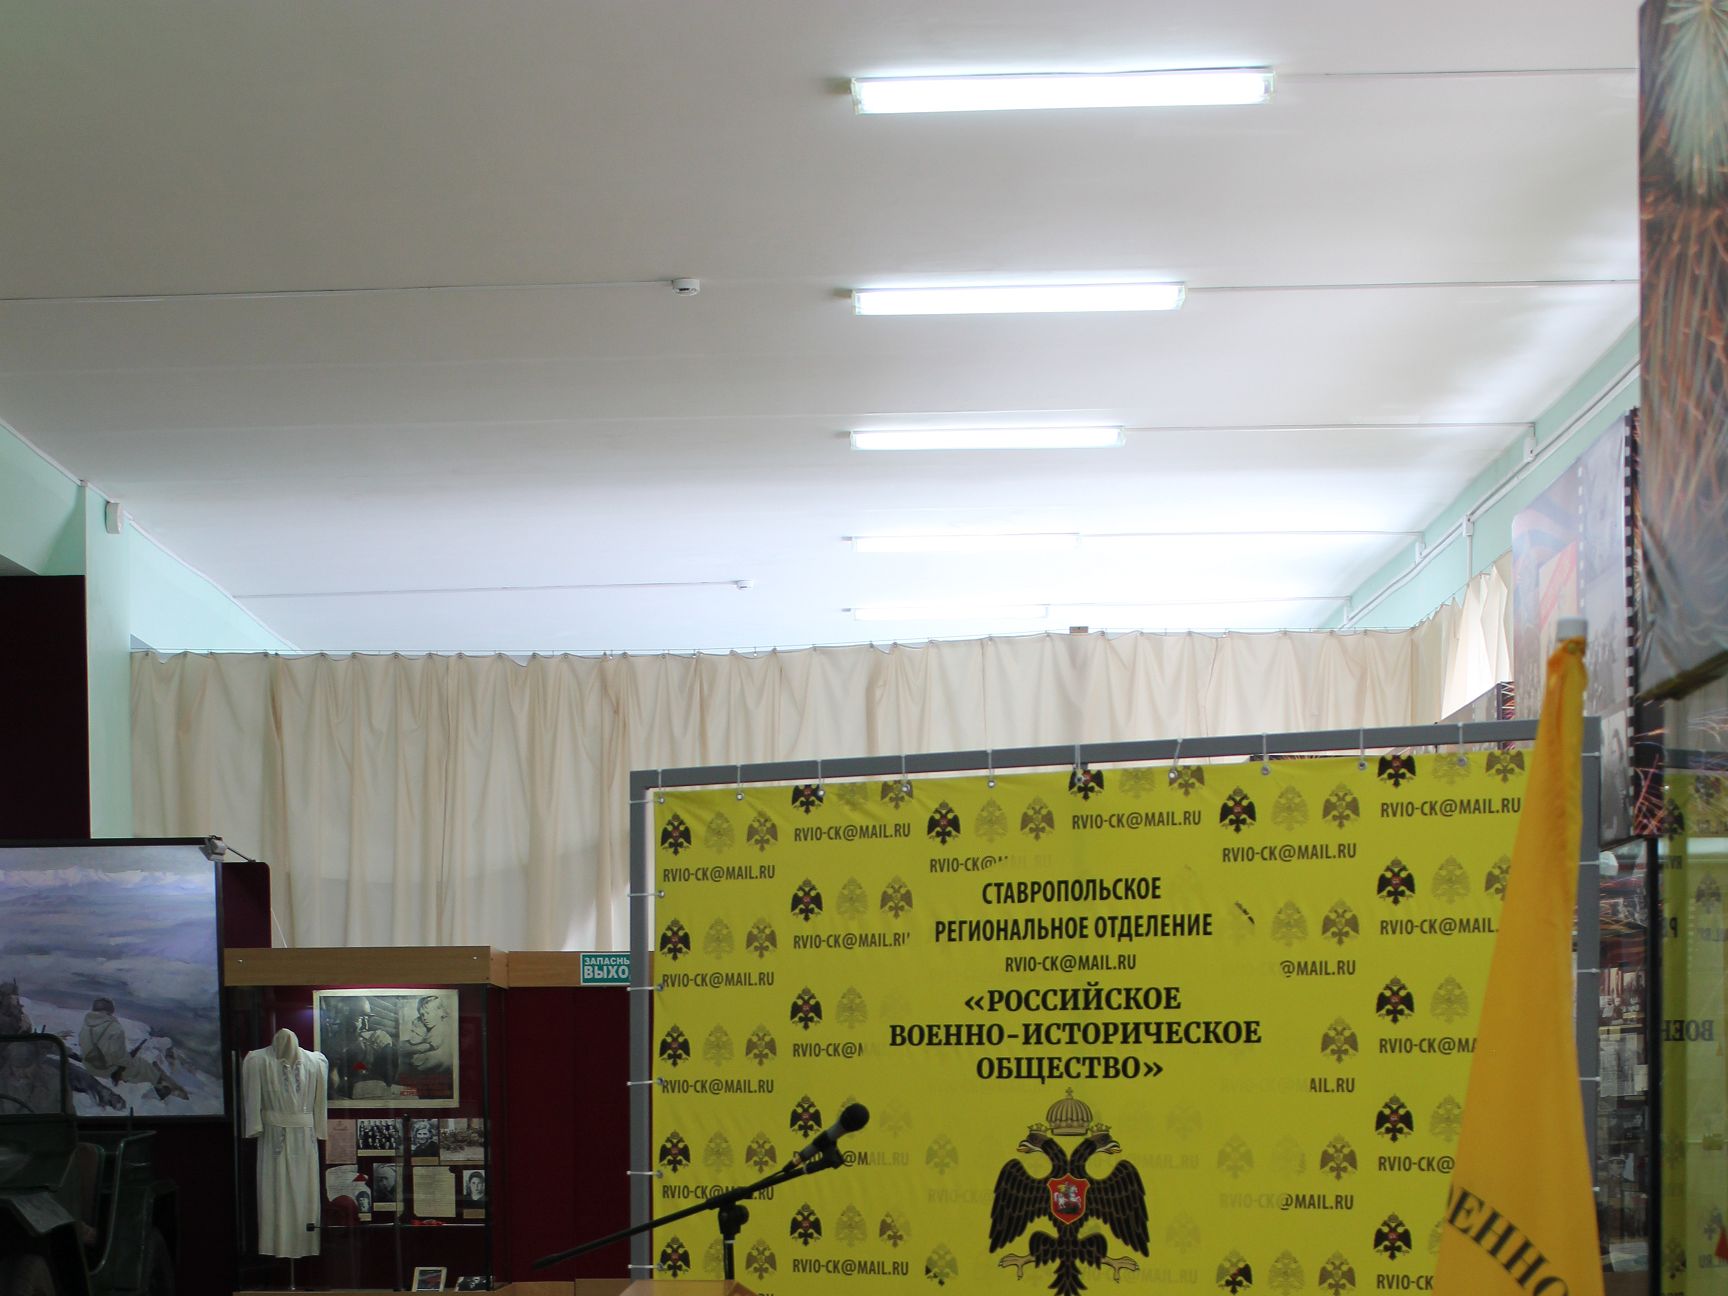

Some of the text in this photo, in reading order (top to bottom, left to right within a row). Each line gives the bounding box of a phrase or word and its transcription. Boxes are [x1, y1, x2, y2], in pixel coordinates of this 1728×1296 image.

[1379, 797, 1521, 818] RVIO-CK@MAIL.RU
[1071, 810, 1202, 831] RVIO-CK@MAIL.RU
[793, 822, 911, 842] RVIO-CK@MAIL.RU
[1222, 842, 1357, 863] RVIO-CK@MAIL.RU
[662, 864, 776, 883] RVIO-CK@MAIL.RU
[982, 876, 1162, 905] СТАВРОПОЛЬСКОЕ
[935, 913, 1213, 943] РЕГИОНАЛЬНОЕ ОТДЕЛЕНИЕ
[583, 965, 631, 979] ВЫХО
[1004, 953, 1137, 973] RVIO-CK@MAIL.RU
[661, 971, 775, 989] RVIO-CK@MAIL.RU
[963, 980, 1182, 1012] «РОССИЙСКОЕ
[888, 1020, 1263, 1047] ВОЕННО-ИСТОРИЧЕСКОЕ
[976, 1055, 1165, 1085] ОБЩЕСТВО»
[661, 1077, 774, 1096] RVIO-CK@MAIL.RU
[1378, 1155, 1457, 1175] RVIO-CK@
[792, 1257, 909, 1277] RVIO-CK@MAIL.RU
[1376, 1273, 1435, 1292] RVIO-CK
